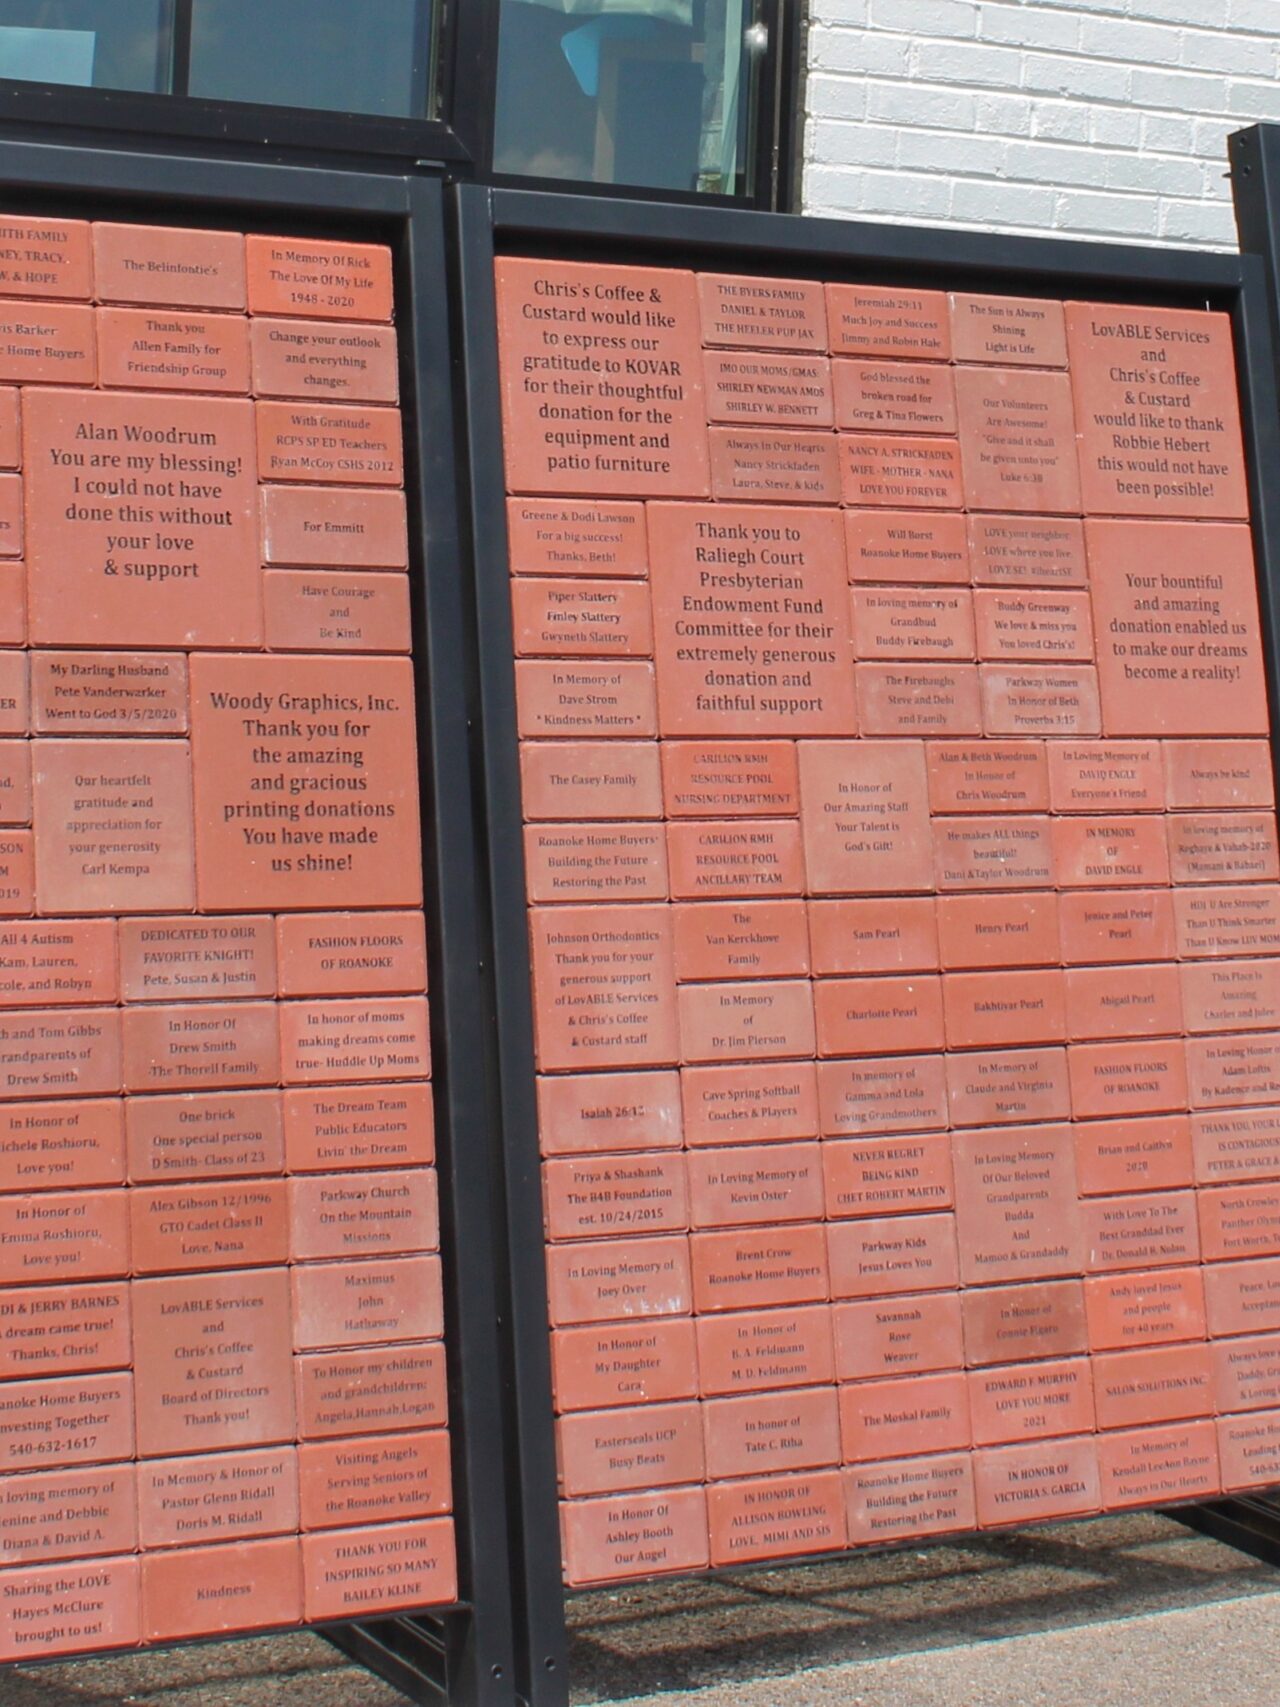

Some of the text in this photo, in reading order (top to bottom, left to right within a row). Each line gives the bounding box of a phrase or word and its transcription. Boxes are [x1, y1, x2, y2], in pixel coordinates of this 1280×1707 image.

[534, 280, 661, 303] Chris's Coffee &
[523, 304, 675, 328] Custard would like
[543, 331, 659, 351] to express our
[1092, 322, 1210, 343] LovABLE Services
[524, 355, 680, 375] gratitude to KOVAR
[1141, 349, 1166, 362] and
[1110, 368, 1200, 386] Chris's Coffee
[524, 377, 682, 403] for their thoughtful
[1125, 391, 1190, 407] & Custard
[539, 403, 672, 424] donation for the
[1094, 412, 1224, 431] would like to thank
[76, 423, 216, 445] Alan Woodrum
[545, 429, 669, 449] equipment and
[1113, 434, 1210, 452] Robbie Hebert
[51, 449, 241, 478] You are my blessing!
[548, 455, 670, 473] patio furniture
[1098, 456, 1228, 475] this would not have
[75, 477, 222, 498] I could not have
[1116, 479, 1213, 498] been possible!
[66, 503, 232, 525] done this without
[304, 521, 364, 533] For Emmitt
[696, 523, 800, 543] Thank you to
[107, 533, 193, 553] your love
[696, 547, 804, 567] Raliegh Court
[104, 559, 198, 581] & support
[700, 572, 803, 591] Presbyterian
[1126, 574, 1222, 589] Your bountiful
[683, 596, 823, 613] Endowment Fund
[1134, 596, 1220, 616] and amazing
[675, 621, 833, 638] Committee for their
[1110, 618, 1247, 634] donation enabled us
[677, 646, 835, 665] extremely generous
[1113, 641, 1248, 656] to make our dreams
[51, 664, 169, 678] My Darling Husband
[705, 670, 811, 686] donation and
[1124, 664, 1240, 683] become a reality!
[55, 686, 166, 697] Pete Vanderwarker
[210, 692, 399, 714] Woody Graphics, Inc.
[697, 695, 822, 715] faithful support
[45, 708, 177, 721] Went to God 3/5/2020
[243, 720, 370, 741] Thank you for
[253, 746, 363, 768] the amazing
[251, 774, 366, 795] and gracious
[550, 774, 636, 786] The Casey Family
[224, 800, 394, 822] printing donations
[243, 827, 377, 844] You have made
[272, 854, 352, 871] us shine!
[309, 936, 403, 948] FASHION FLOORS
[853, 928, 900, 939] Sam Pearl
[321, 957, 392, 969] OF ROANOKE
[579, 1208, 663, 1224] est. 10/24/2015
[10, 1436, 96, 1455] 540-632-1617
[1008, 1464, 1068, 1481] IN HONOR OF
[995, 1489, 1040, 1503] VICTORIA
[1051, 1482, 1086, 1495] GARCIA
[197, 1585, 251, 1600] Kindness
